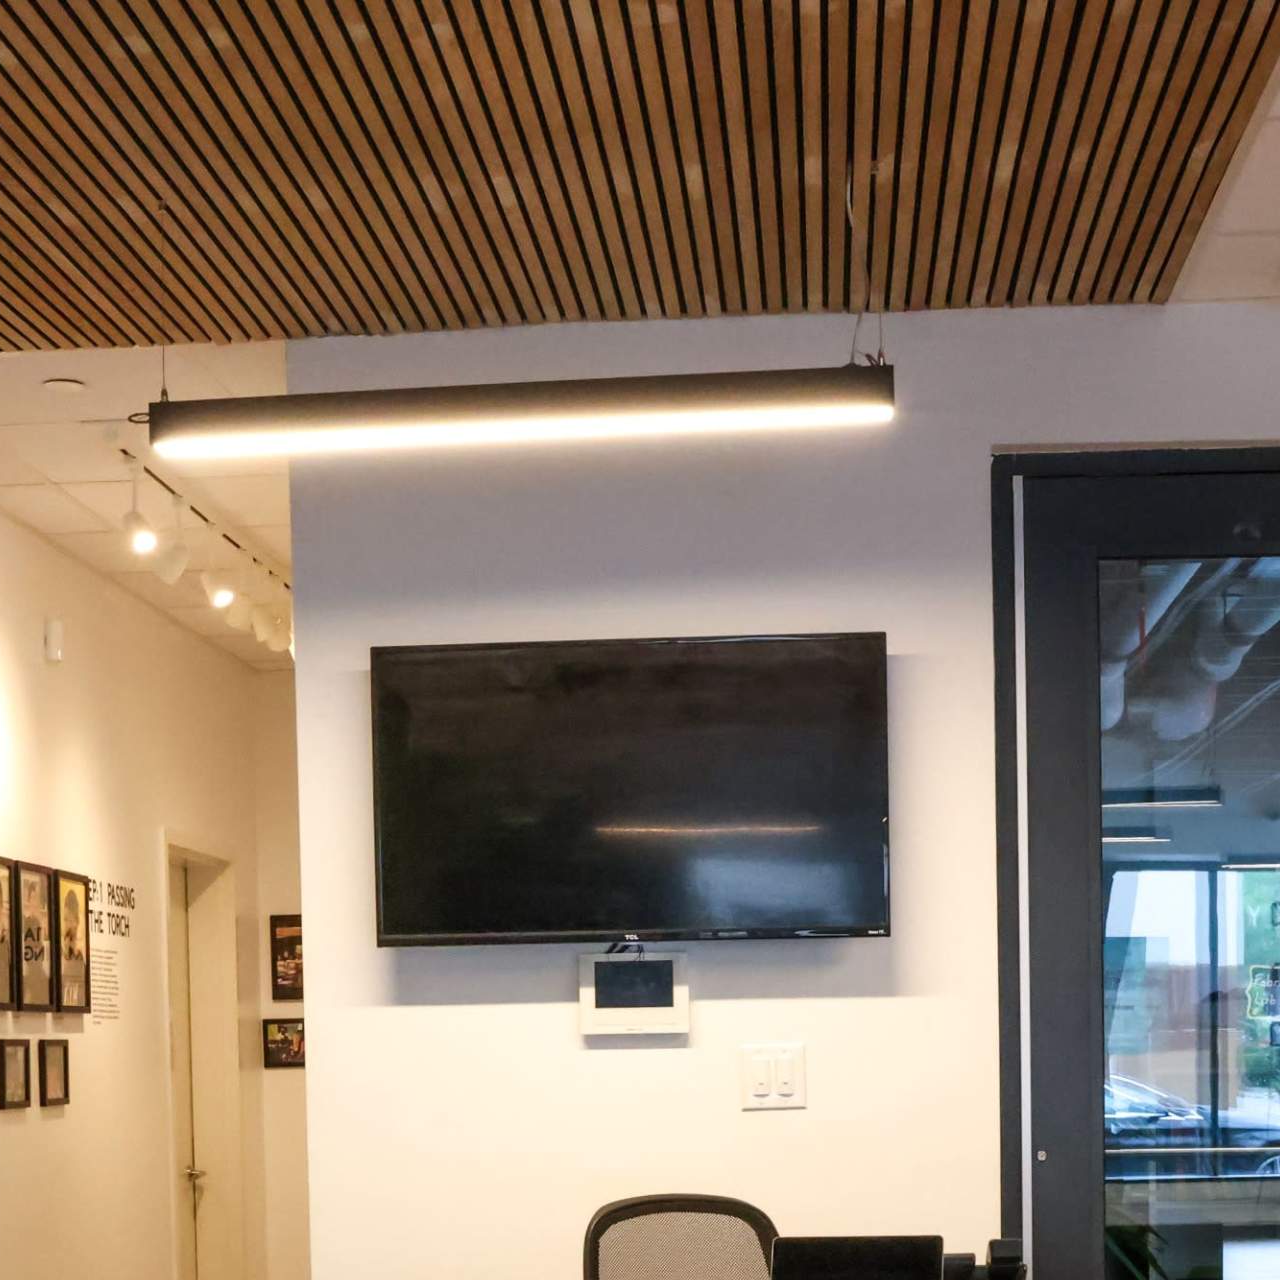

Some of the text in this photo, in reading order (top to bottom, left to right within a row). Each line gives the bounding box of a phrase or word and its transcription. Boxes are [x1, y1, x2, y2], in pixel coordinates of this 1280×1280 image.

[107, 882, 135, 910] PASSING
[88, 909, 130, 938] THE TORCH
